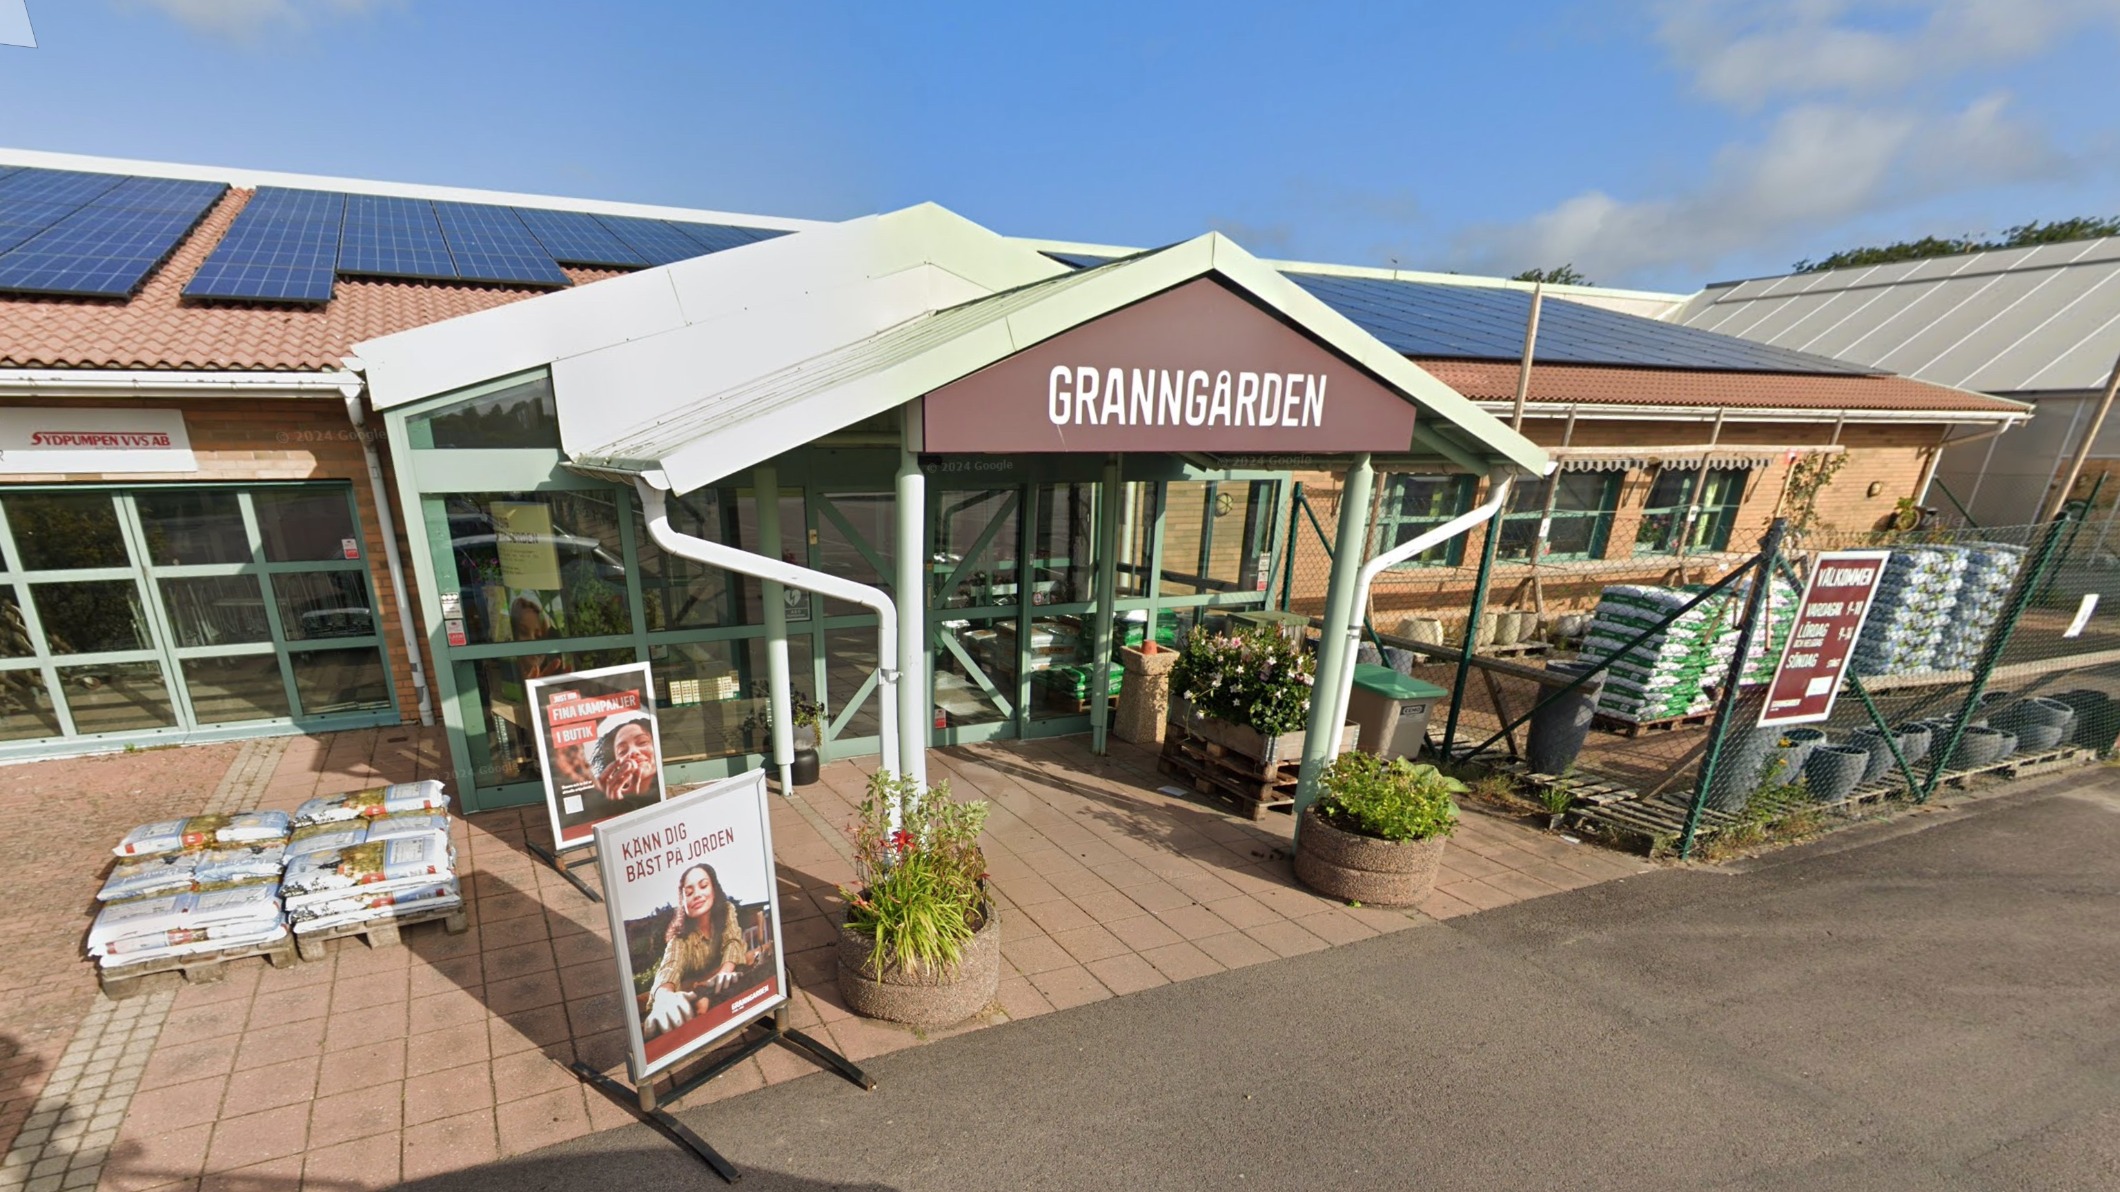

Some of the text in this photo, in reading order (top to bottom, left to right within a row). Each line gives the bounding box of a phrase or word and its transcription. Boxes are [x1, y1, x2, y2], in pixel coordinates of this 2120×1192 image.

[1048, 365, 1327, 427] GRANNGÅRDEN
[31, 431, 171, 447] SYDPUMPEN VVS AB
[1817, 567, 1875, 587] VÄLKOMMEN
[1797, 621, 1830, 638] LÖRDAG
[1785, 652, 1819, 668] SÖNDAG
[552, 705, 577, 721] FINA
[577, 695, 637, 716] KAMPANJER
[562, 726, 594, 742] BUTIK
[621, 822, 688, 861] KÄNN DIG
[626, 827, 735, 883] BÄST PÅ JORDEN
